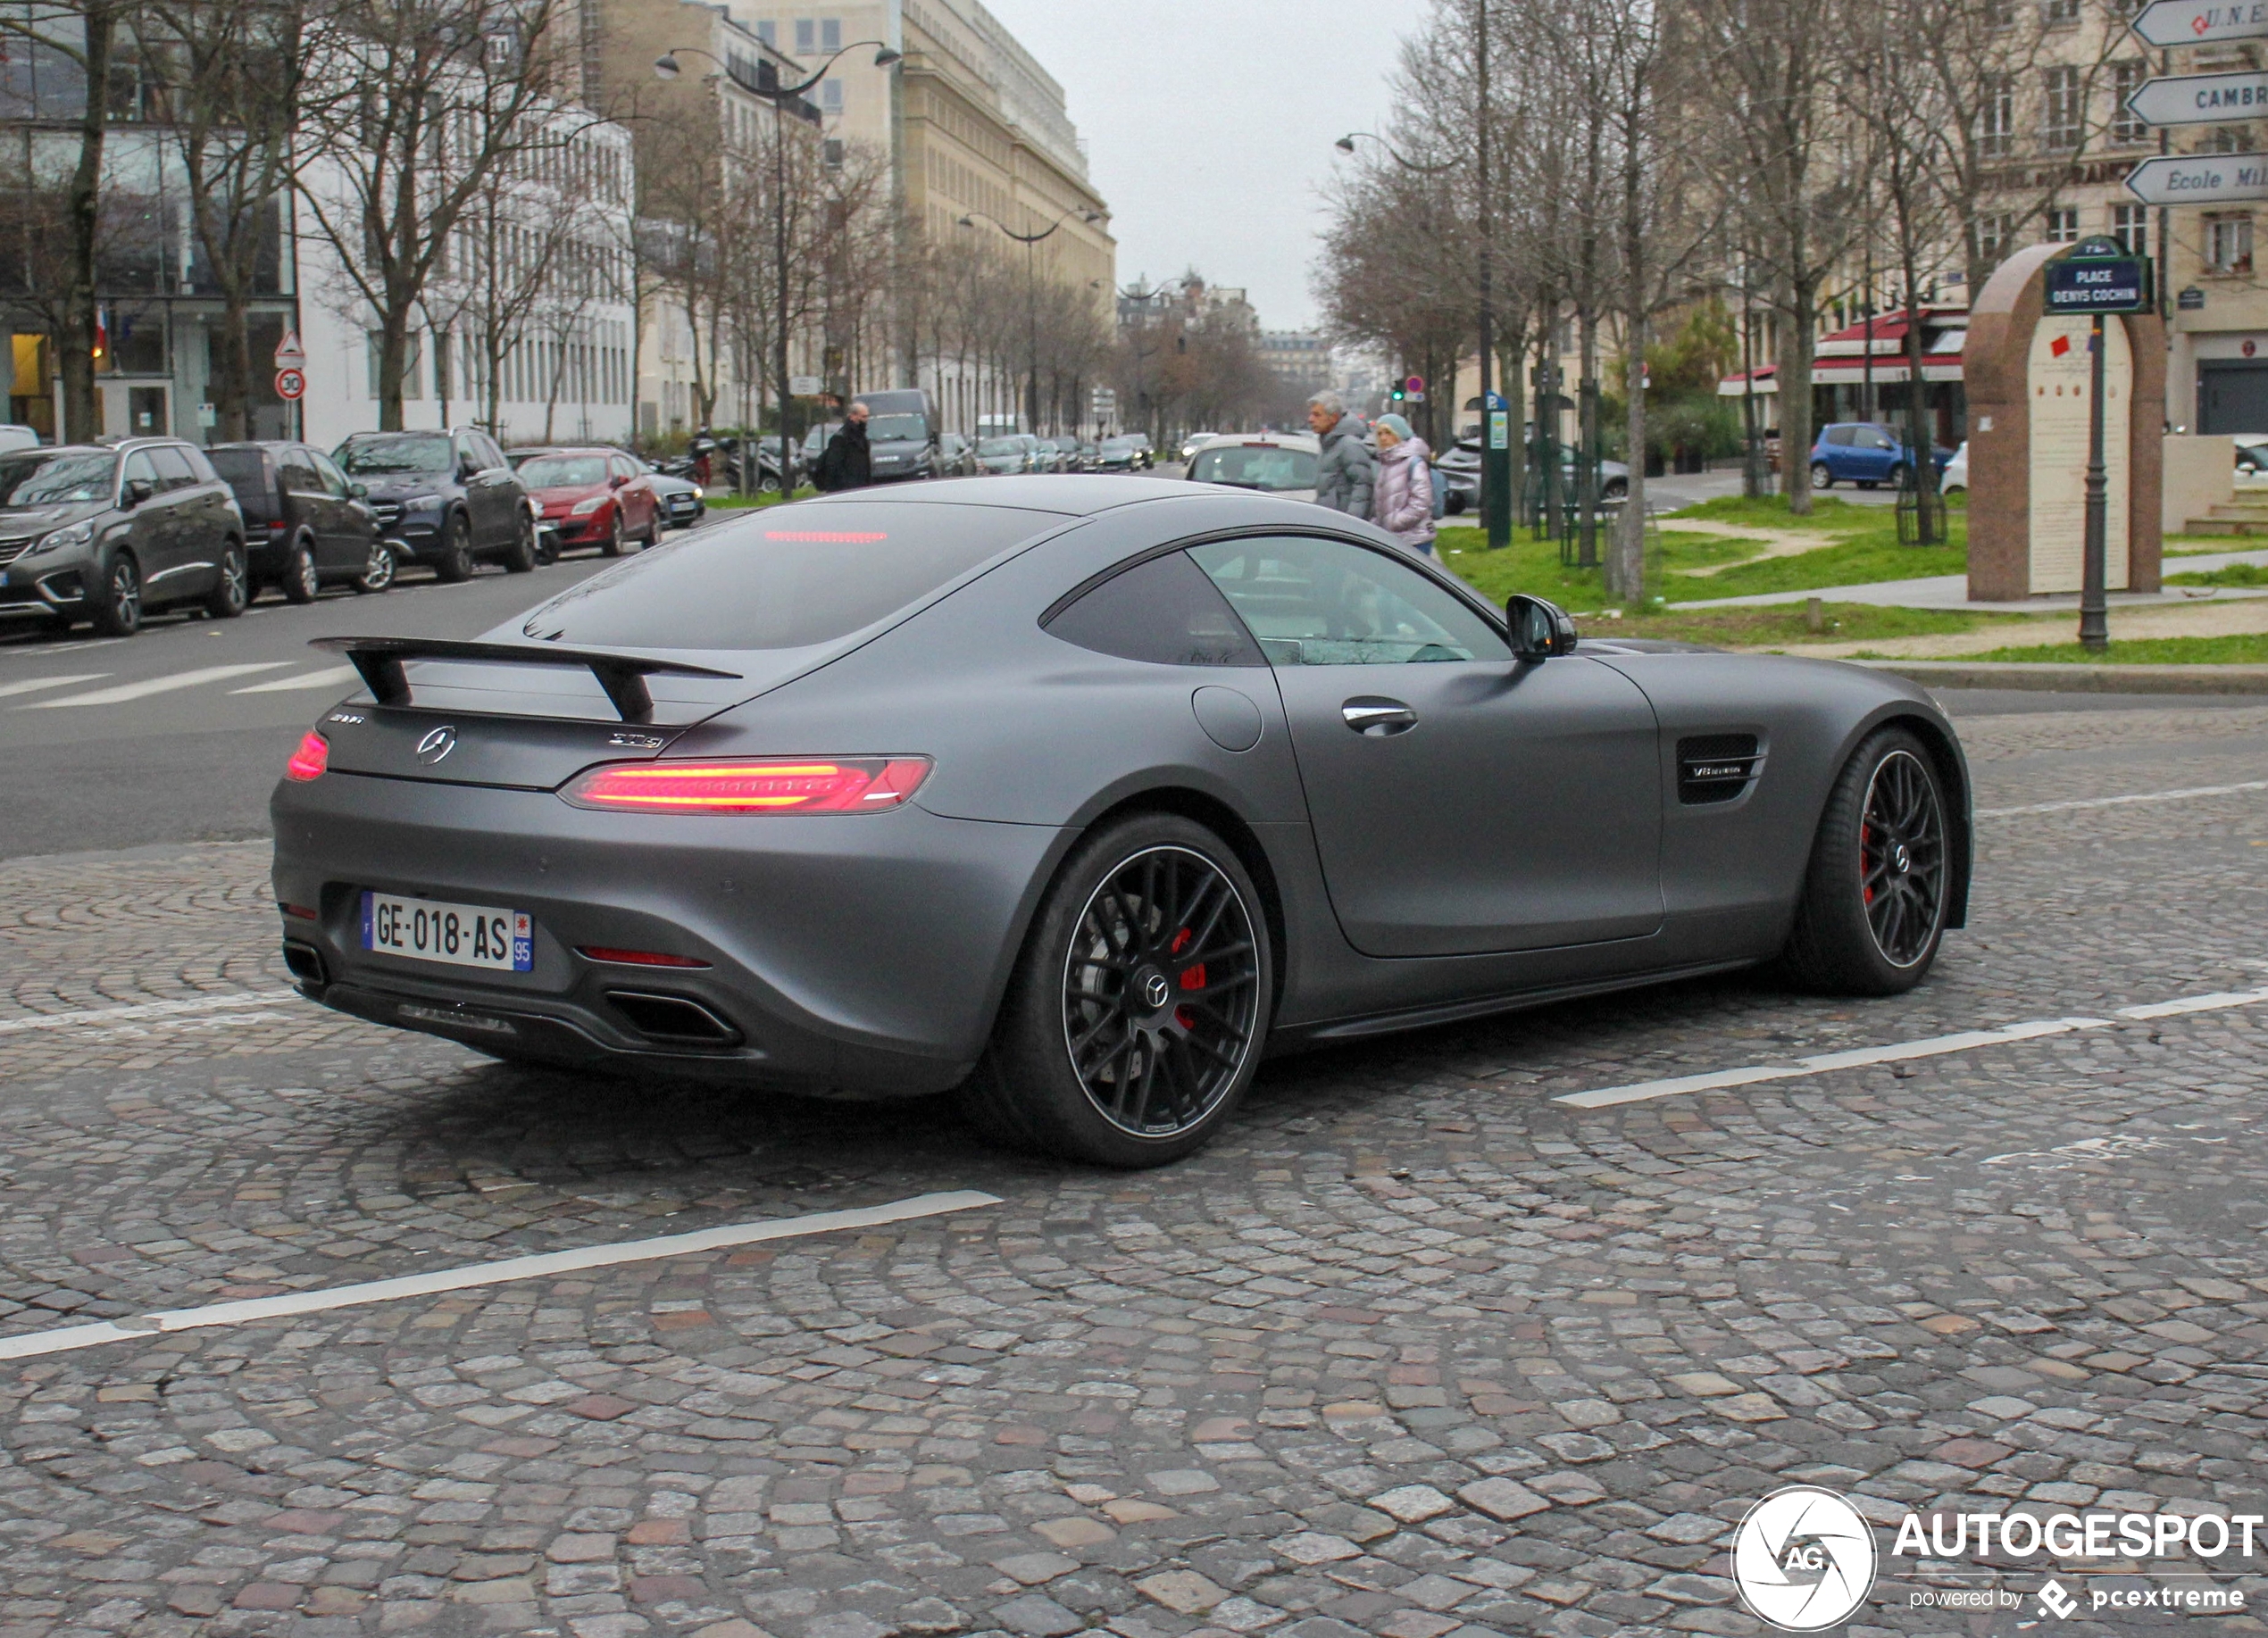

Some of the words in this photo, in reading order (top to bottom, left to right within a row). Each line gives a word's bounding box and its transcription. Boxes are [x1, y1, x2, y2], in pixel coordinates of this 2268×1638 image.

[2075, 270, 2114, 284] PLACE
[2091, 287, 2137, 302] COCHIN
[282, 377, 301, 391] 30
[378, 902, 508, 961] GE-018-AS
[514, 941, 530, 962] 95
